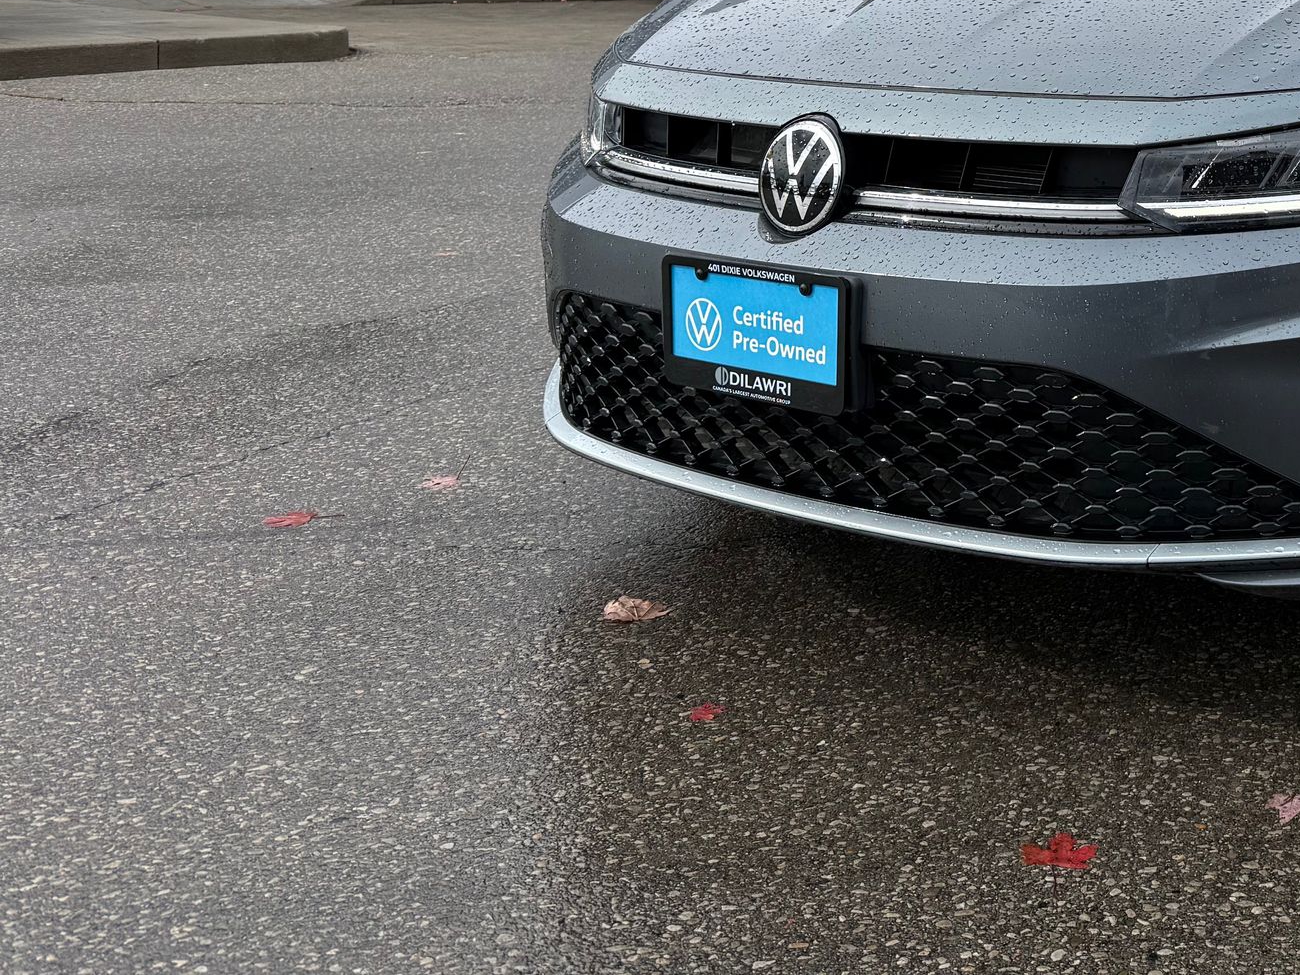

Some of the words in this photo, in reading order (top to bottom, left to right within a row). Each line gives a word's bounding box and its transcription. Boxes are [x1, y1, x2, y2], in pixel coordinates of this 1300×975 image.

[707, 263, 720, 273] 401
[721, 265, 741, 276] DIXIE
[742, 267, 796, 283] VOLKSWAGEN
[732, 305, 804, 335] Certified
[732, 331, 826, 365] Pre-Owned
[729, 371, 791, 397] DILAWRI
